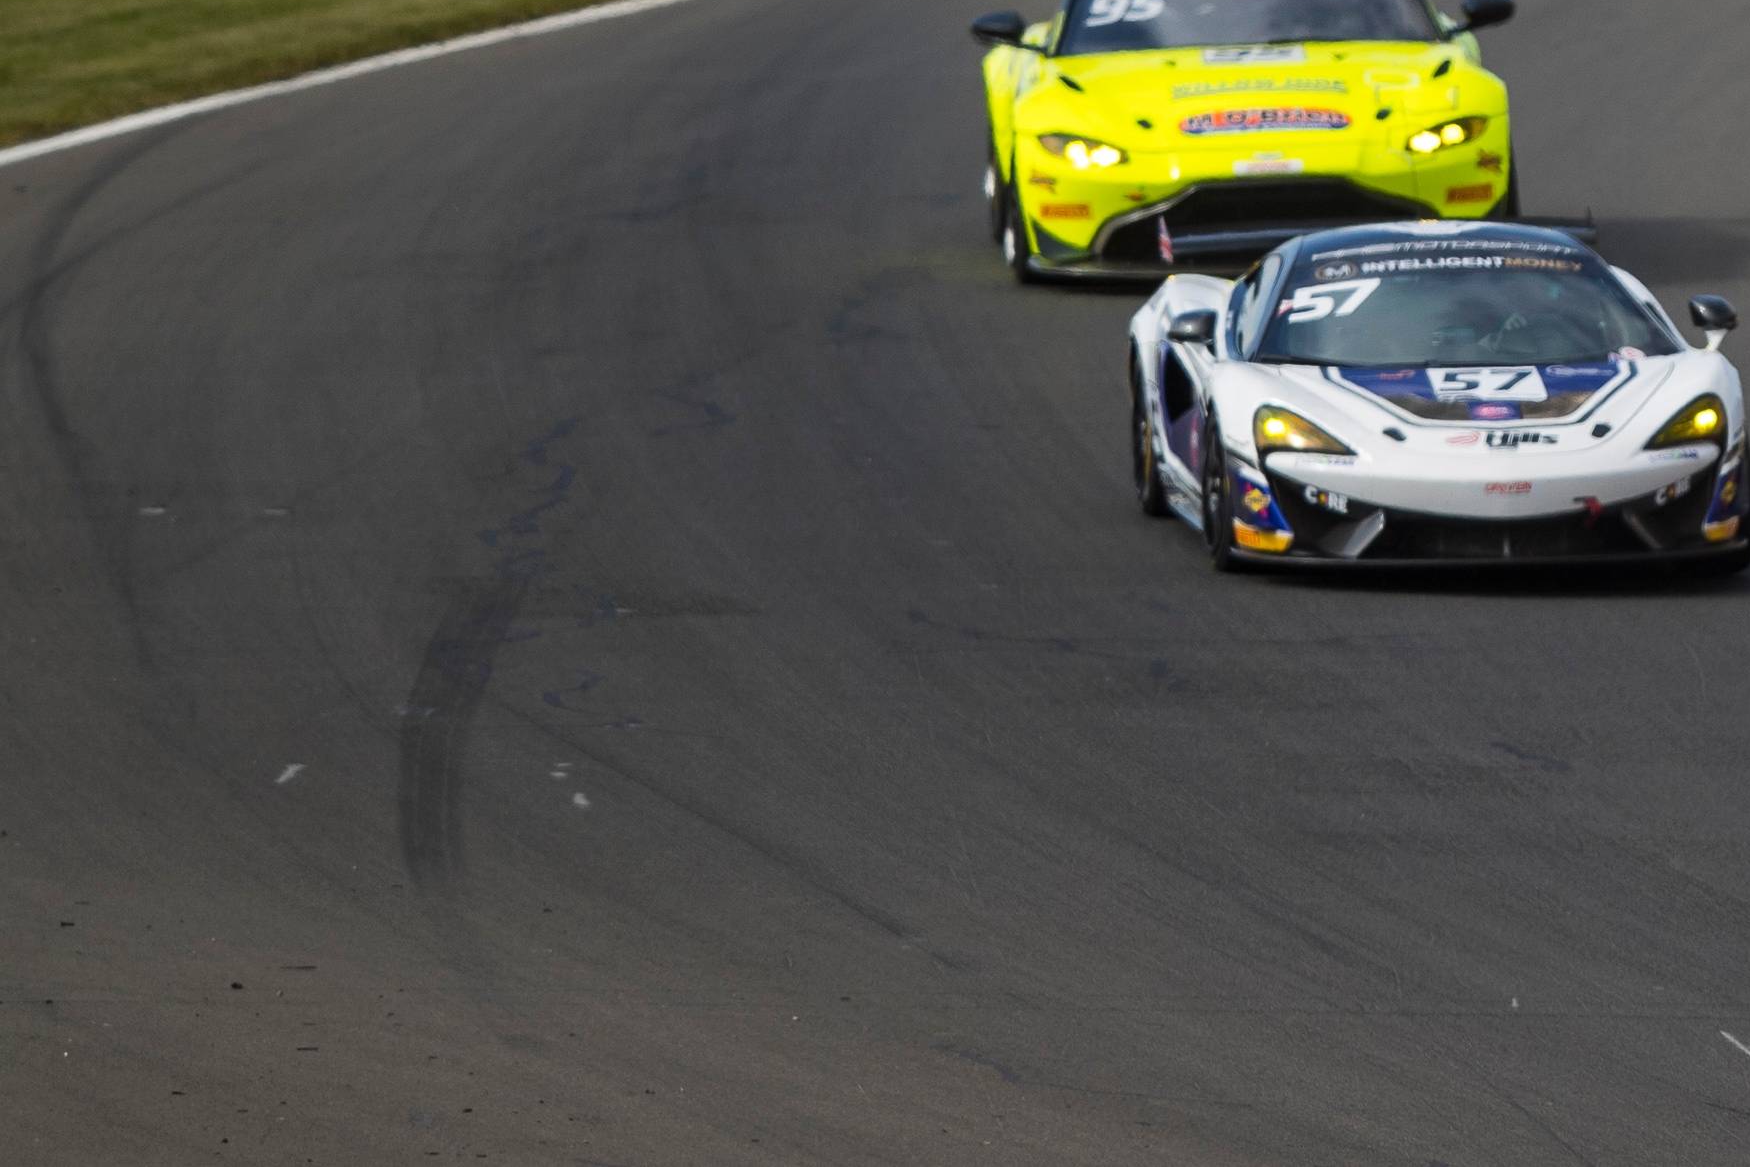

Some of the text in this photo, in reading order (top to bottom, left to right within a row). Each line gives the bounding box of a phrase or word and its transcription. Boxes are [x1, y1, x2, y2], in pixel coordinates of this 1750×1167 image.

[1361, 256, 1584, 274] INTELLIGENTMONEY
[1289, 278, 1381, 324] 57
[1439, 371, 1533, 392] 57
